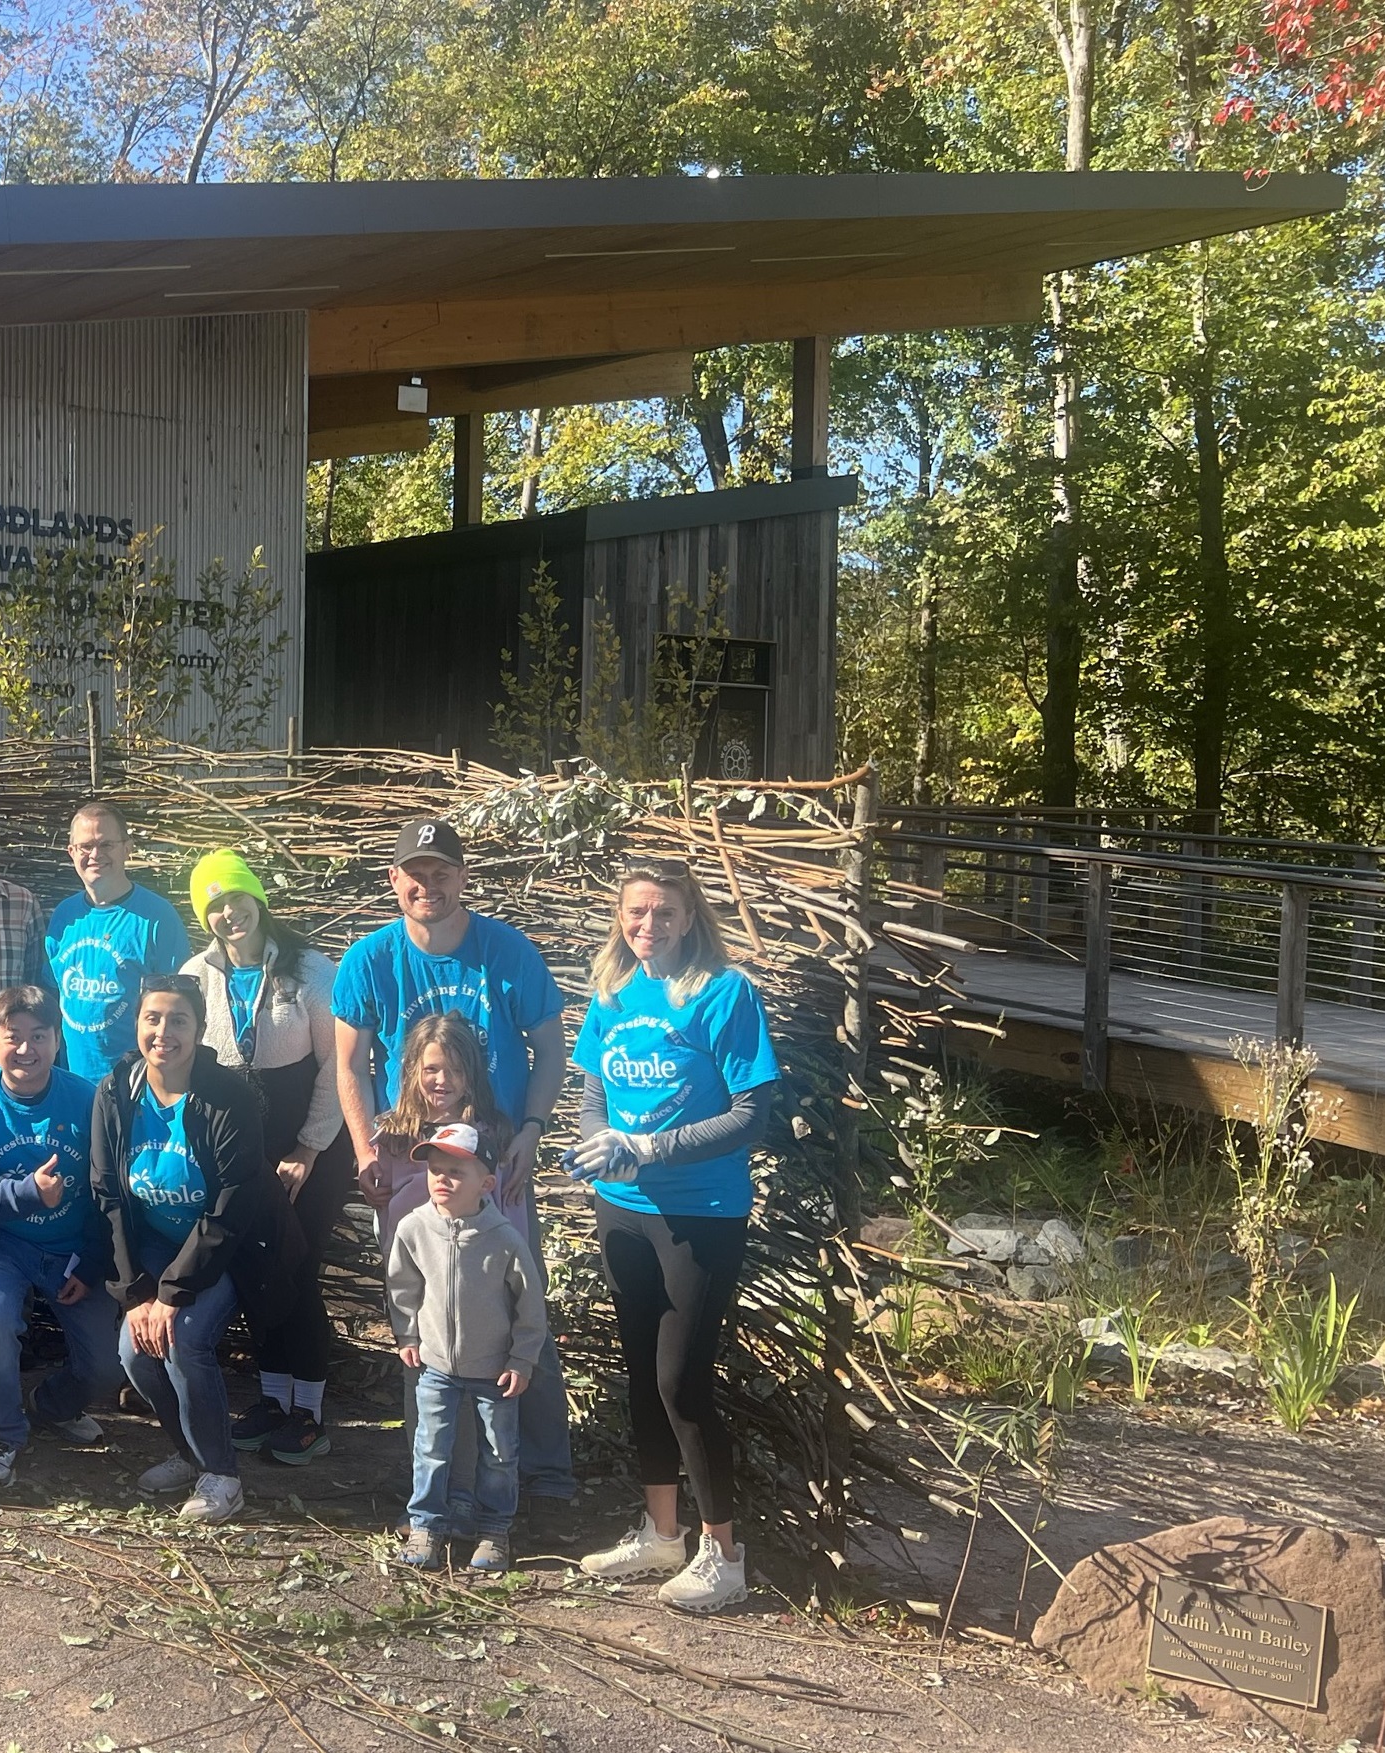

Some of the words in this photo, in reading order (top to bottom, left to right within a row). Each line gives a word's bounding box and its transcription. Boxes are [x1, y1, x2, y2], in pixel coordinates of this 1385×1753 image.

[416, 824, 436, 848] B
[112, 951, 127, 970] our
[69, 973, 118, 998] apple
[400, 985, 458, 1020] investing
[461, 984, 476, 997] in
[604, 1014, 660, 1046] investing
[612, 1052, 677, 1084] apple
[639, 1105, 674, 1125] since
[46, 1134, 60, 1147] in
[63, 1145, 83, 1161] our
[137, 1185, 206, 1207] apple
[1160, 1608, 1211, 1632] Judith
[1215, 1621, 1253, 1642] Ann
[1259, 1629, 1313, 1657] Bailey
[1162, 1634, 1186, 1646] wit
[1187, 1639, 1224, 1654] camera
[1226, 1649, 1246, 1660] and
[1247, 1652, 1307, 1674] wanderlust,
[1221, 1658, 1249, 1674] filled
[1251, 1665, 1268, 1678] her
